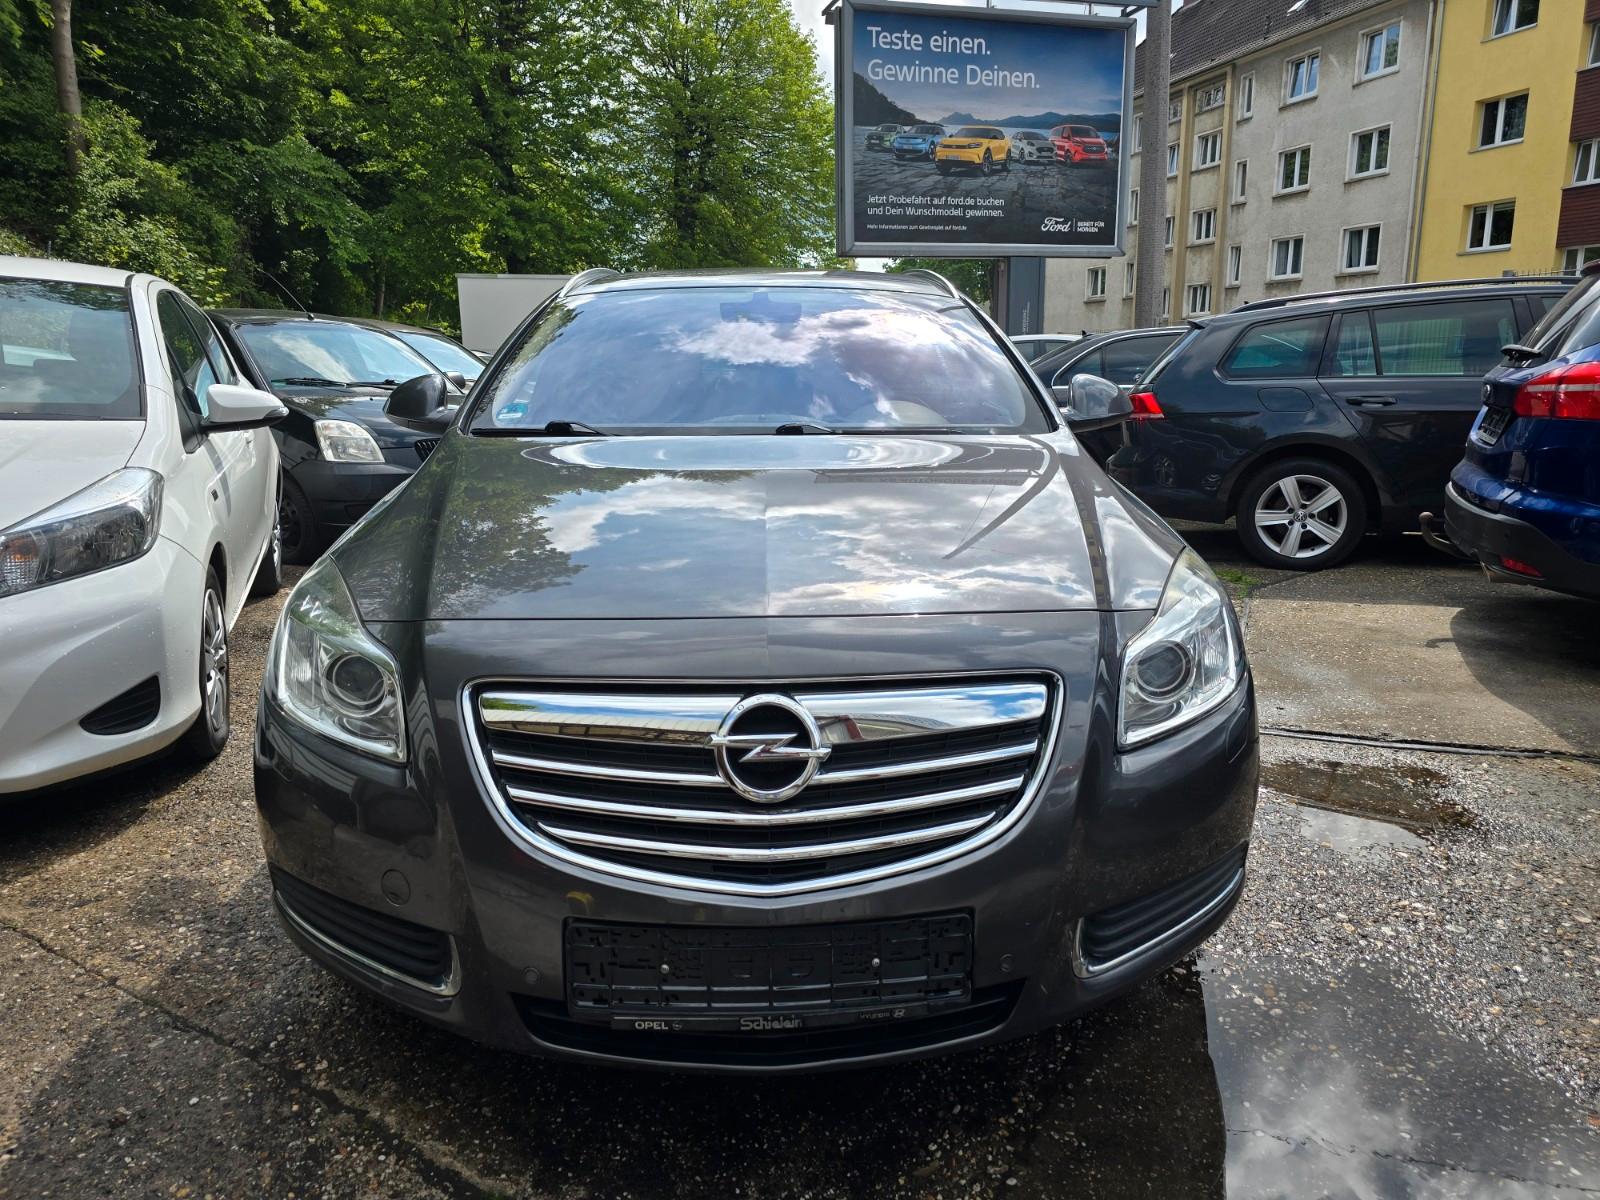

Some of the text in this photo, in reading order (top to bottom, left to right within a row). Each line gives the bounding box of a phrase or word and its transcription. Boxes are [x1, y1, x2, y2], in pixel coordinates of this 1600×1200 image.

[867, 26, 991, 55] Teste einen.
[867, 59, 1040, 89] Gewinne Deinen.
[867, 195, 1005, 206] Jetzt Probefahrt auf ford.de buchen
[867, 206, 1004, 218] und Dein Wunschmodell gewinnen.
[1041, 216, 1072, 232] Ford
[634, 1021, 669, 1030] OPEL
